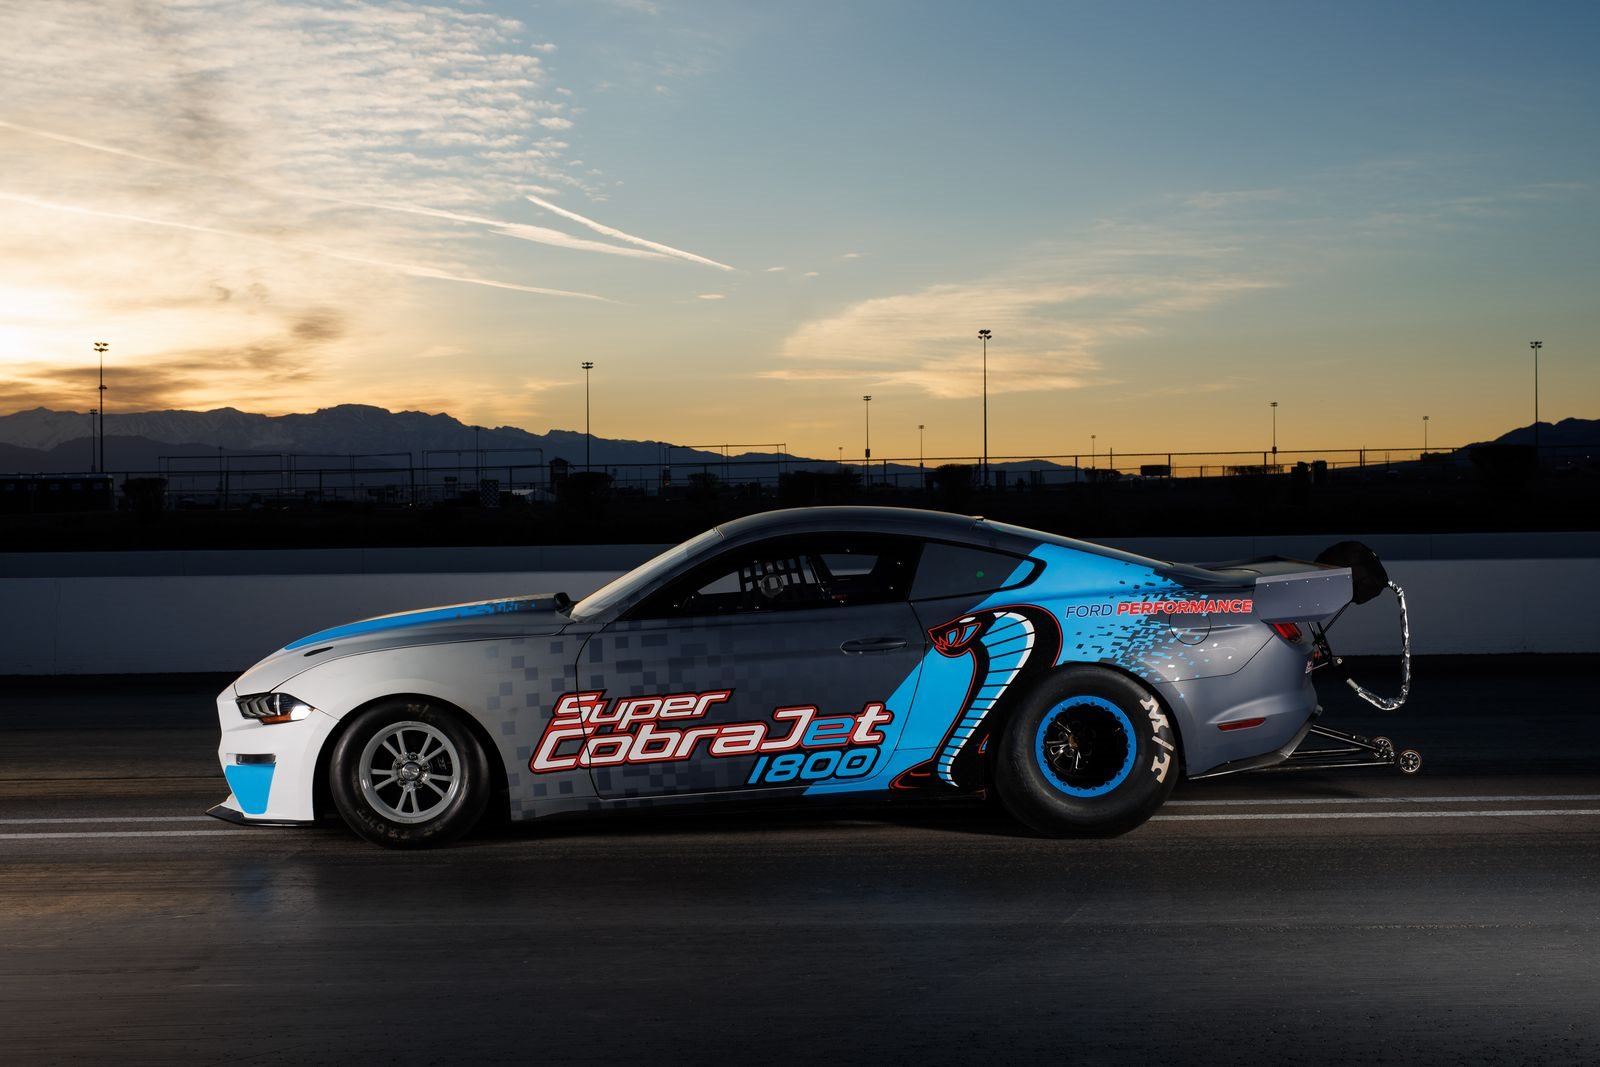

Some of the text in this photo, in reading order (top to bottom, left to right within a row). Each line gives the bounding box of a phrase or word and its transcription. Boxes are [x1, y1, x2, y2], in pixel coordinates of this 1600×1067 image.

[1065, 599, 1253, 619] FORD PERFORMANCE
[552, 689, 732, 731] Super
[1139, 695, 1175, 784] M/T
[746, 747, 874, 785] 1800
